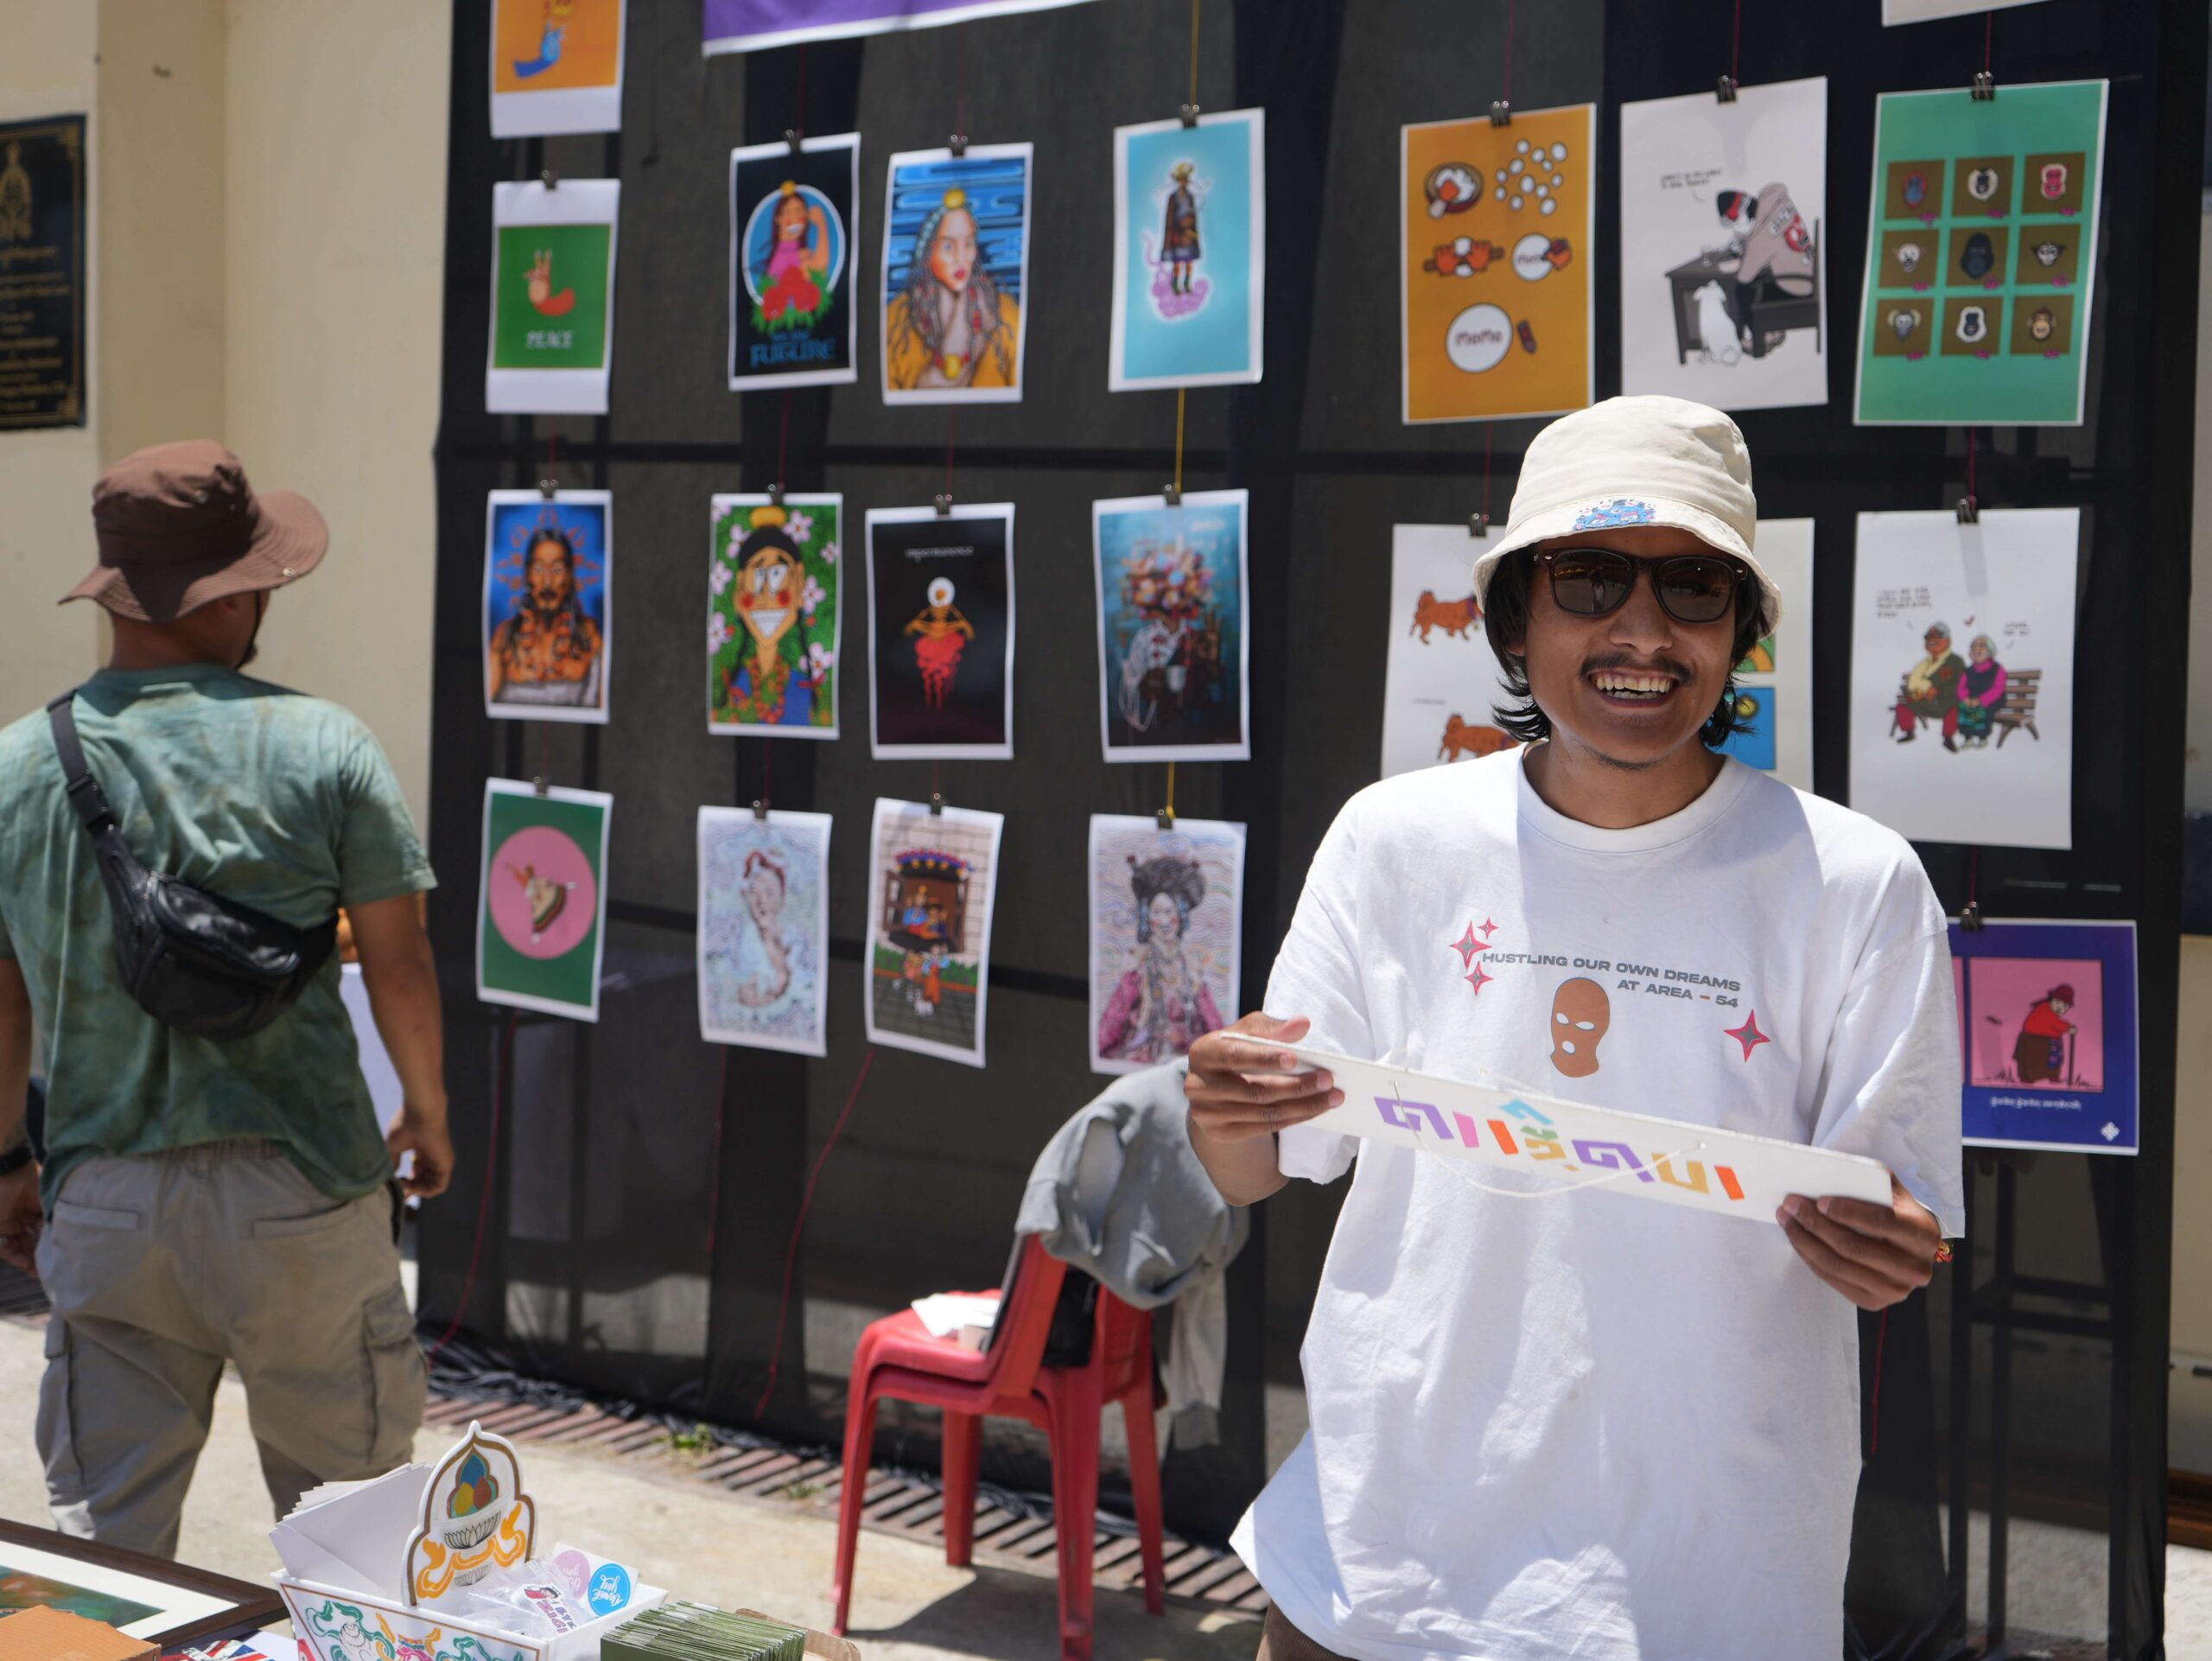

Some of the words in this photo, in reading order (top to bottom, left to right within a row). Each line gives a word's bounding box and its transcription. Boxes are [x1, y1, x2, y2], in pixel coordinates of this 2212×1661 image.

[1482, 952, 1568, 967] HUSTLING
[1573, 958, 1611, 971] OUR
[1616, 963, 1659, 977] OWN
[1664, 969, 1741, 992] DREAMS
[1618, 979, 1640, 991] AT
[1645, 983, 1693, 1000] AREA
[1715, 995, 1738, 1009] 54
